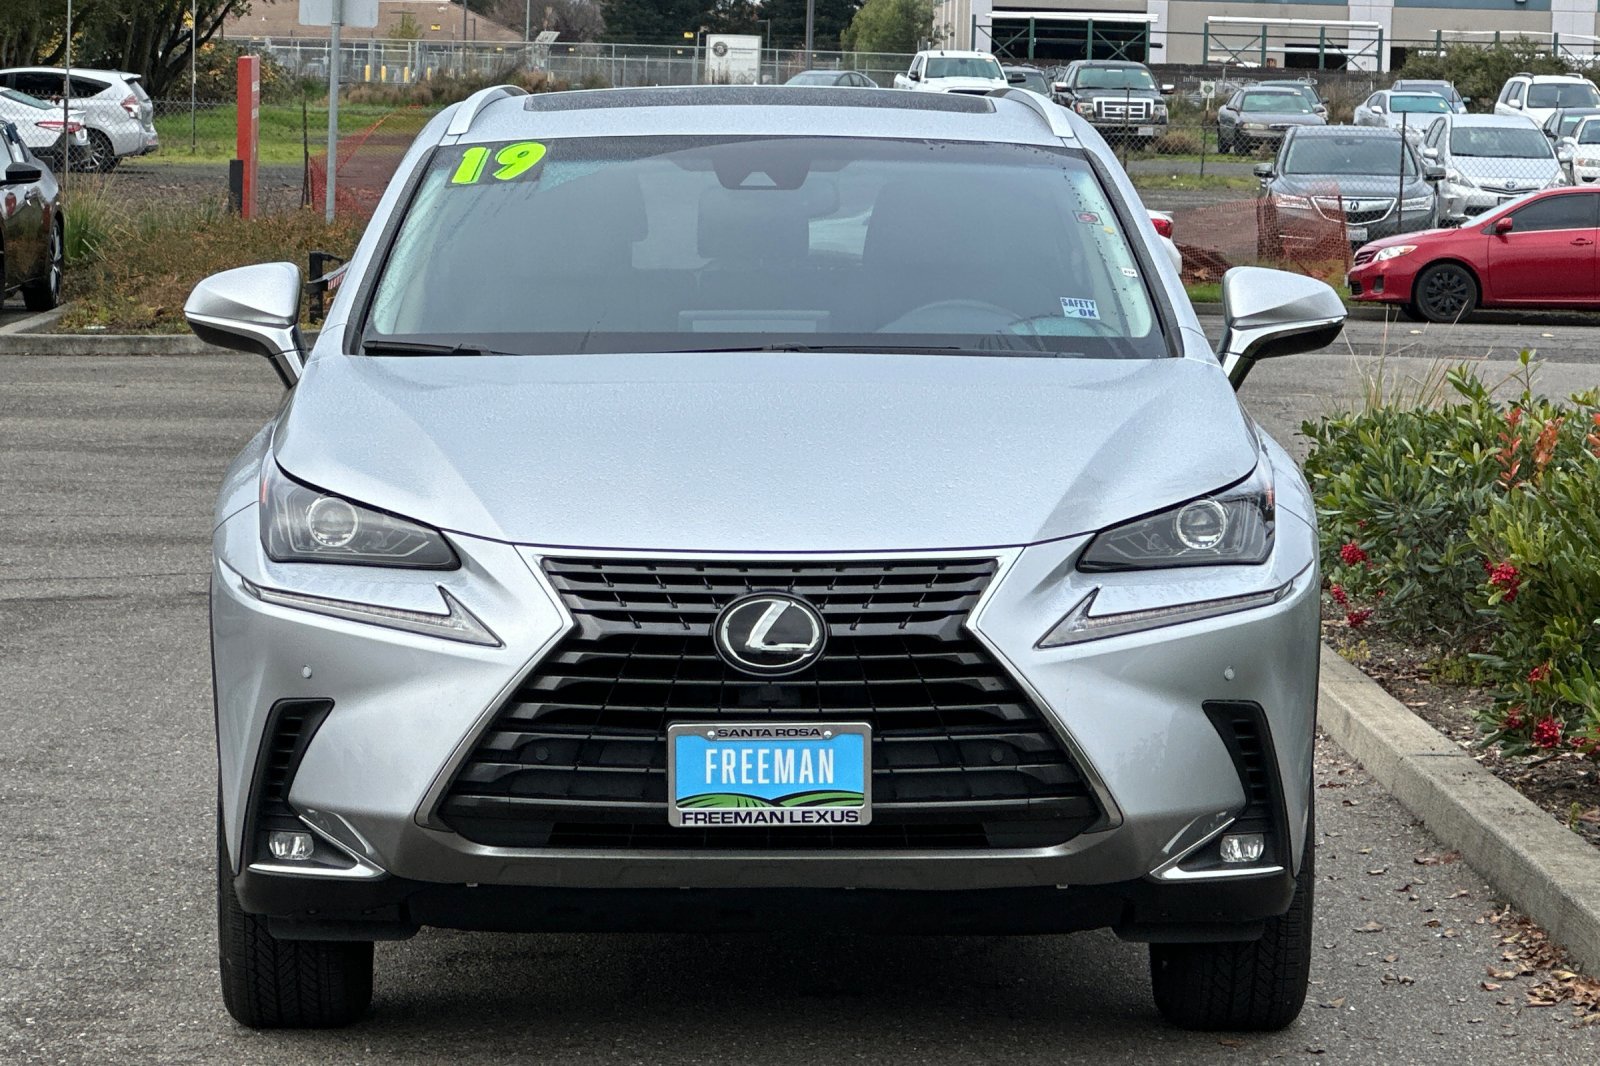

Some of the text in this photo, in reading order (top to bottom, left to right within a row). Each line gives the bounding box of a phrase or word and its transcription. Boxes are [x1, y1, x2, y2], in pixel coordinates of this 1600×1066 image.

[452, 142, 546, 184] 19
[1061, 299, 1095, 308] SAFETY
[1079, 309, 1096, 317] OK
[717, 728, 821, 737] SANTA ROSA
[705, 748, 834, 784] FREEMAN
[682, 810, 859, 824] FREEMAN LEXUS
